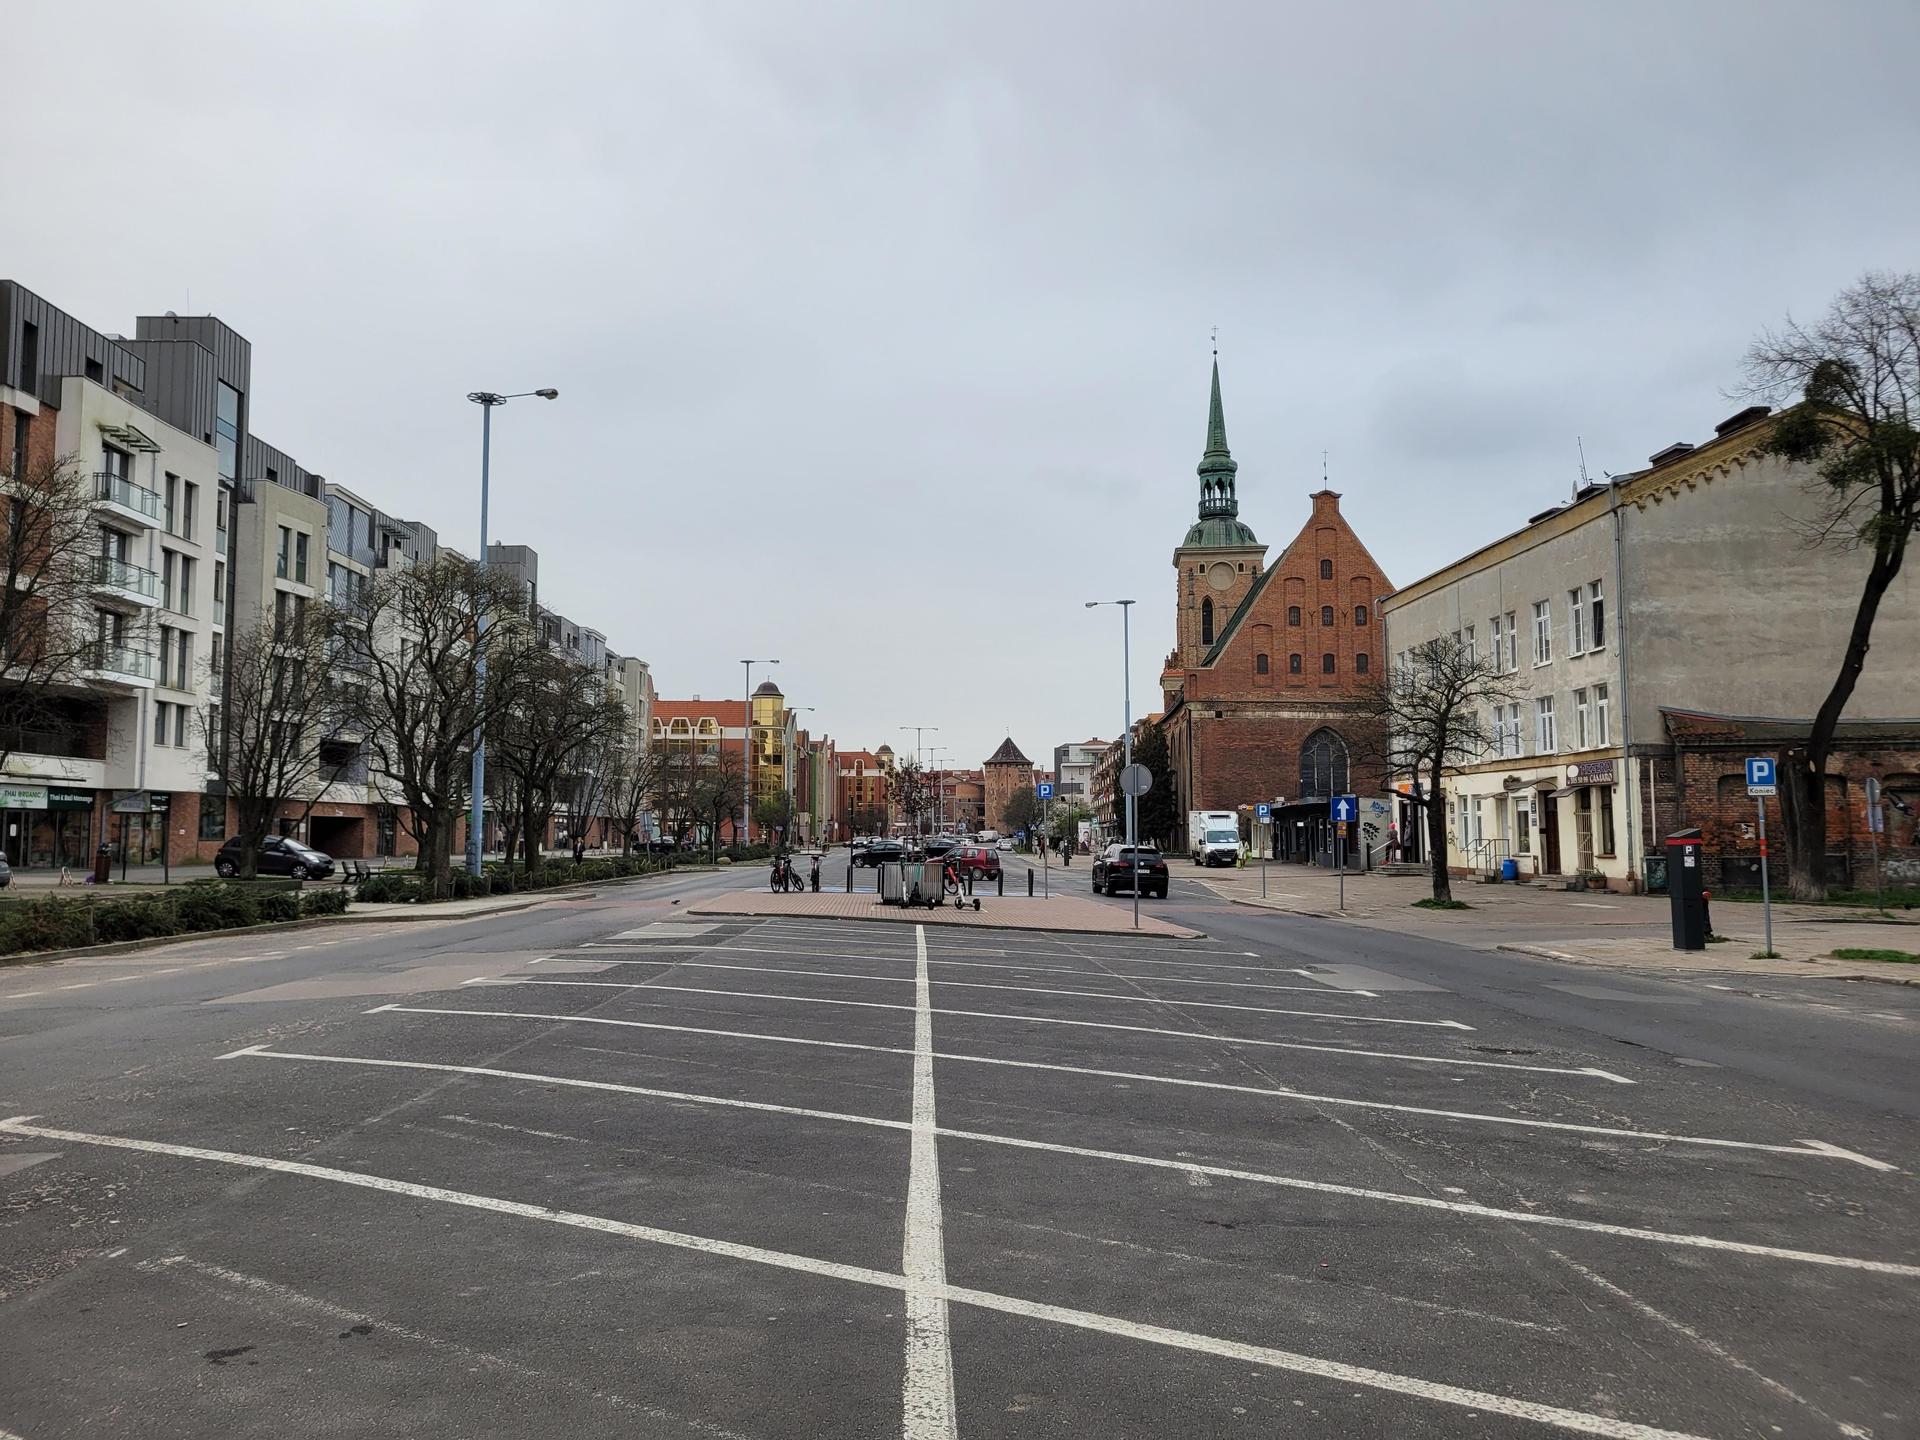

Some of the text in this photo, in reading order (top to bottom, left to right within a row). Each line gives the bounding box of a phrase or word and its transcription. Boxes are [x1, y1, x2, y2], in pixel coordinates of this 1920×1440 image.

[1752, 761, 1769, 782] P
[1040, 786, 1050, 796] P
[1260, 805, 1267, 816] P
[1686, 846, 1692, 854] P
